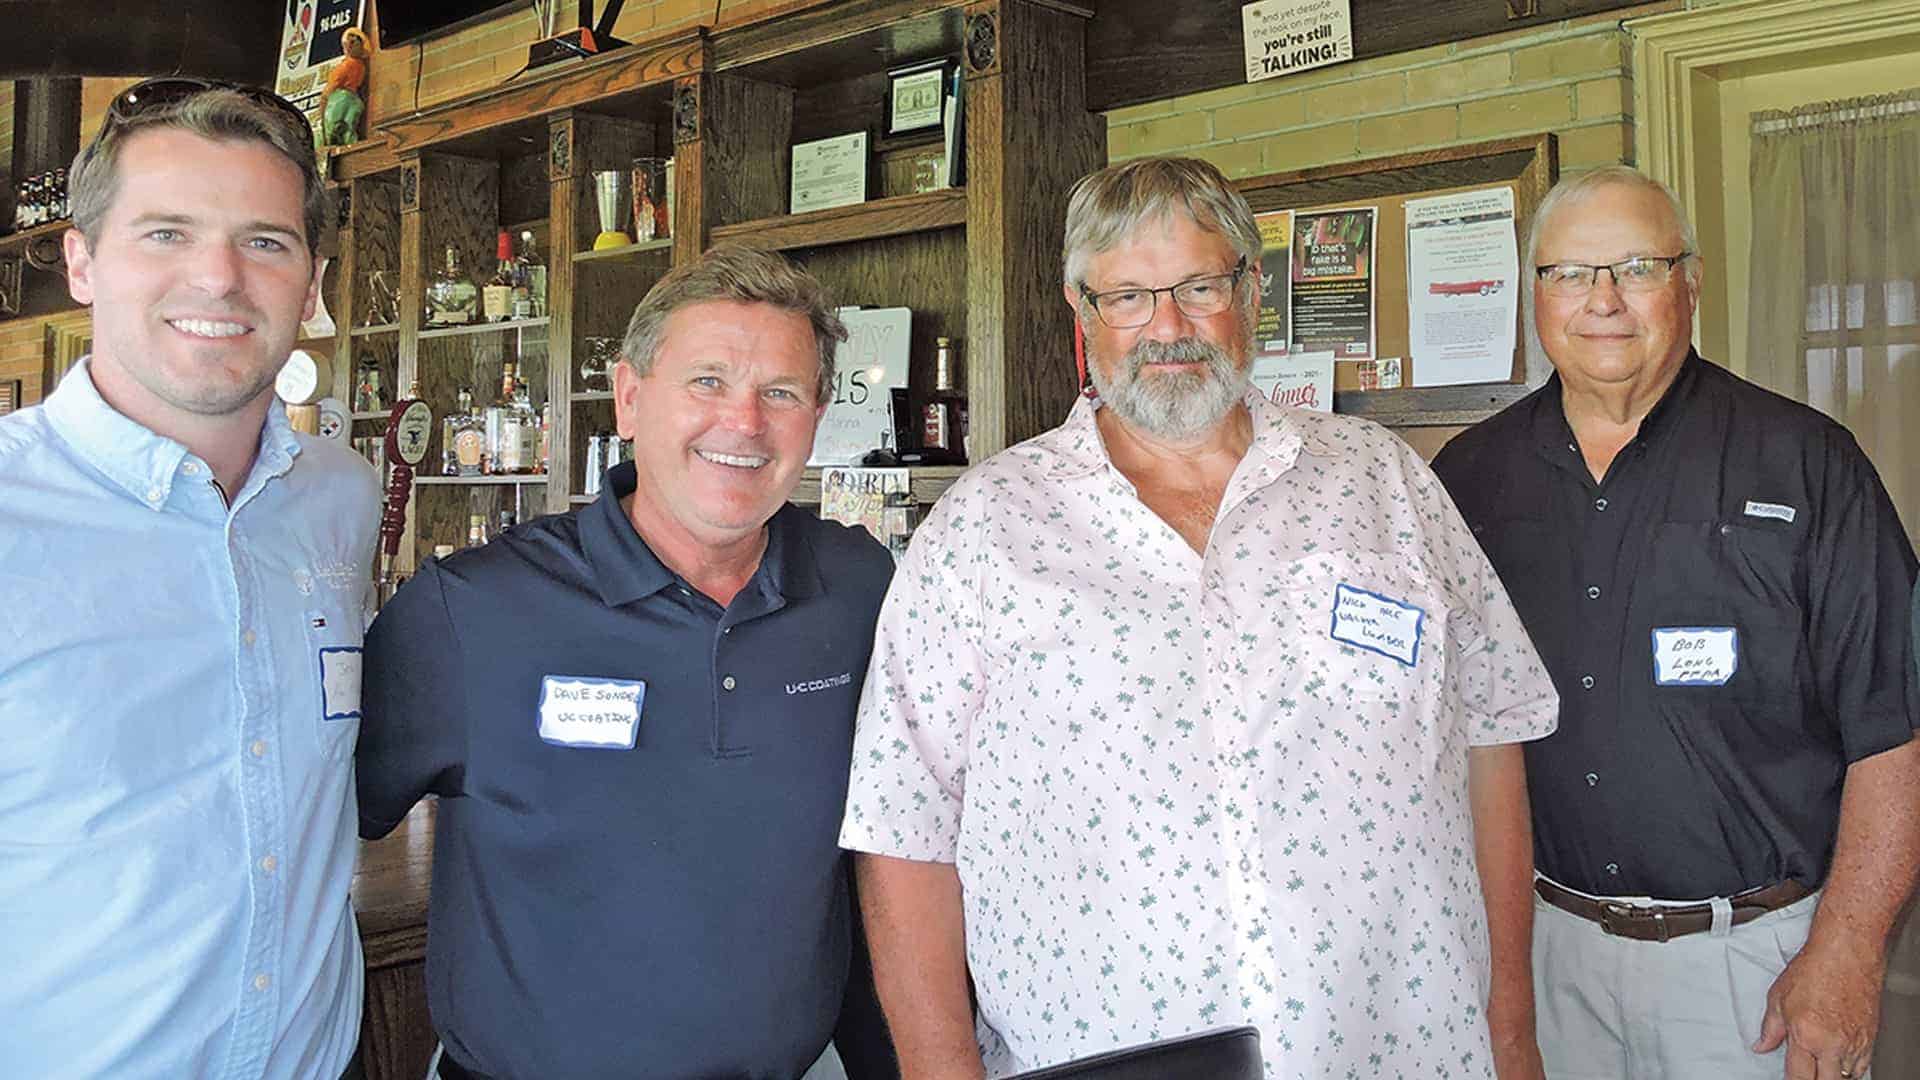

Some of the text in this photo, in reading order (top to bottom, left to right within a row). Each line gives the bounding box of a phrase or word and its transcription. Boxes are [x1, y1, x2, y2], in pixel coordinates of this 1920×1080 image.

[330, 9, 351, 29] CALS
[1252, 27, 1268, 38] the
[1269, 23, 1289, 34] look
[1290, 19, 1303, 29] on
[1303, 16, 1318, 27] my
[1264, 23, 1333, 54] you're still
[1261, 42, 1338, 74] TALKING!
[1672, 638, 1707, 652] BOB
[1672, 656, 1714, 670] LONG
[554, 687, 591, 701] DAVE
